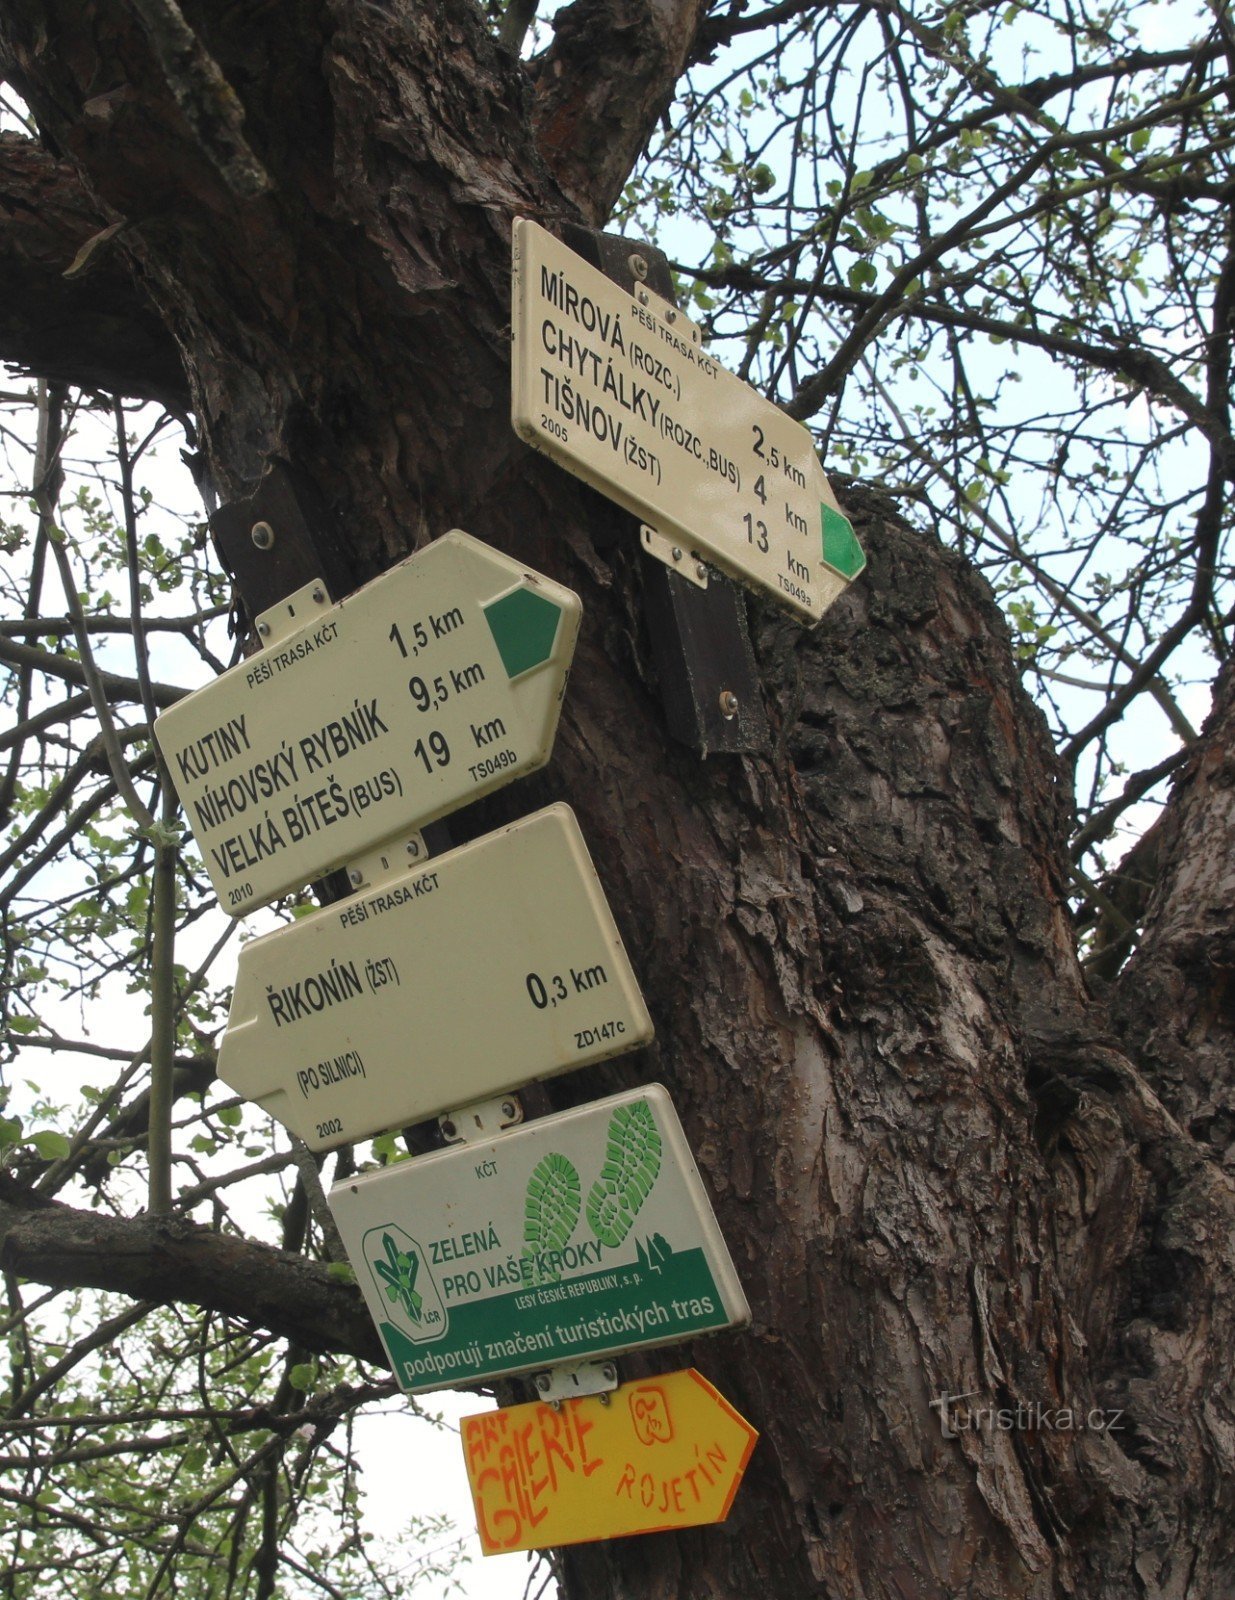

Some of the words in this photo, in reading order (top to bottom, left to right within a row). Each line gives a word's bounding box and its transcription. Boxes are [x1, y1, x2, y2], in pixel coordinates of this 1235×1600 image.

[632, 304, 657, 334] PĚŠÍ
[657, 320, 695, 362] TRASA
[695, 354, 719, 380] KČT
[541, 265, 624, 356] MÍROVÁ
[629, 342, 681, 401] (ROZC.)
[752, 425, 779, 468] 2,5
[783, 455, 806, 489] km
[541, 320, 661, 427] CHYTÁLKY
[753, 474, 767, 505] 4
[785, 503, 808, 536] km
[541, 414, 569, 442] 2005
[541, 367, 623, 452] TIŠNOV
[743, 513, 769, 554] 13
[787, 551, 810, 583] km
[777, 574, 812, 607] TS049a
[246, 658, 273, 689] PĚŠÍ
[273, 638, 314, 674] TRASA
[312, 622, 339, 651] KČT
[175, 715, 251, 784] KUTINY
[389, 622, 429, 658] 1,5
[429, 606, 464, 639] km
[193, 741, 300, 832] NÍHOVSKÝ
[298, 699, 389, 773] RYBNÍK
[409, 676, 449, 713] 9,5
[449, 661, 486, 693] km
[468, 750, 517, 783] TS049b
[211, 815, 287, 879] VELKÁ
[286, 775, 350, 843] BÍTEŠ
[348, 768, 403, 818] (BUS)
[413, 731, 451, 774] 19
[470, 717, 507, 748] km
[228, 883, 254, 906] 2010
[339, 902, 369, 929] PĚŠÍ
[369, 888, 414, 917] TRASA
[412, 874, 440, 901] KČT
[266, 959, 363, 1027] ŘIKONÍN
[365, 957, 400, 994] (ŽST)
[525, 973, 567, 1009] 0,3
[570, 964, 607, 995] km
[574, 1021, 626, 1050] ZD147c
[297, 1066, 321, 1099] (PO
[321, 1051, 366, 1086] SILNICI)
[316, 1118, 343, 1139] 2002
[475, 1161, 498, 1180] KČT
[428, 1221, 501, 1265] ZELENÁ
[442, 1275, 482, 1299] PRO
[485, 1253, 535, 1289] VAŠE
[534, 1241, 603, 1277] KROKY
[423, 1308, 441, 1325] LČR
[515, 1294, 538, 1310] LESY
[537, 1284, 568, 1305] ČESKÉ
[403, 1344, 482, 1380] podporují
[485, 1329, 554, 1360] značení
[555, 1303, 667, 1346] turistických
[671, 1295, 715, 1320] tras
[466, 1412, 509, 1475] ART
[616, 1442, 728, 1513] ROJETÍN
